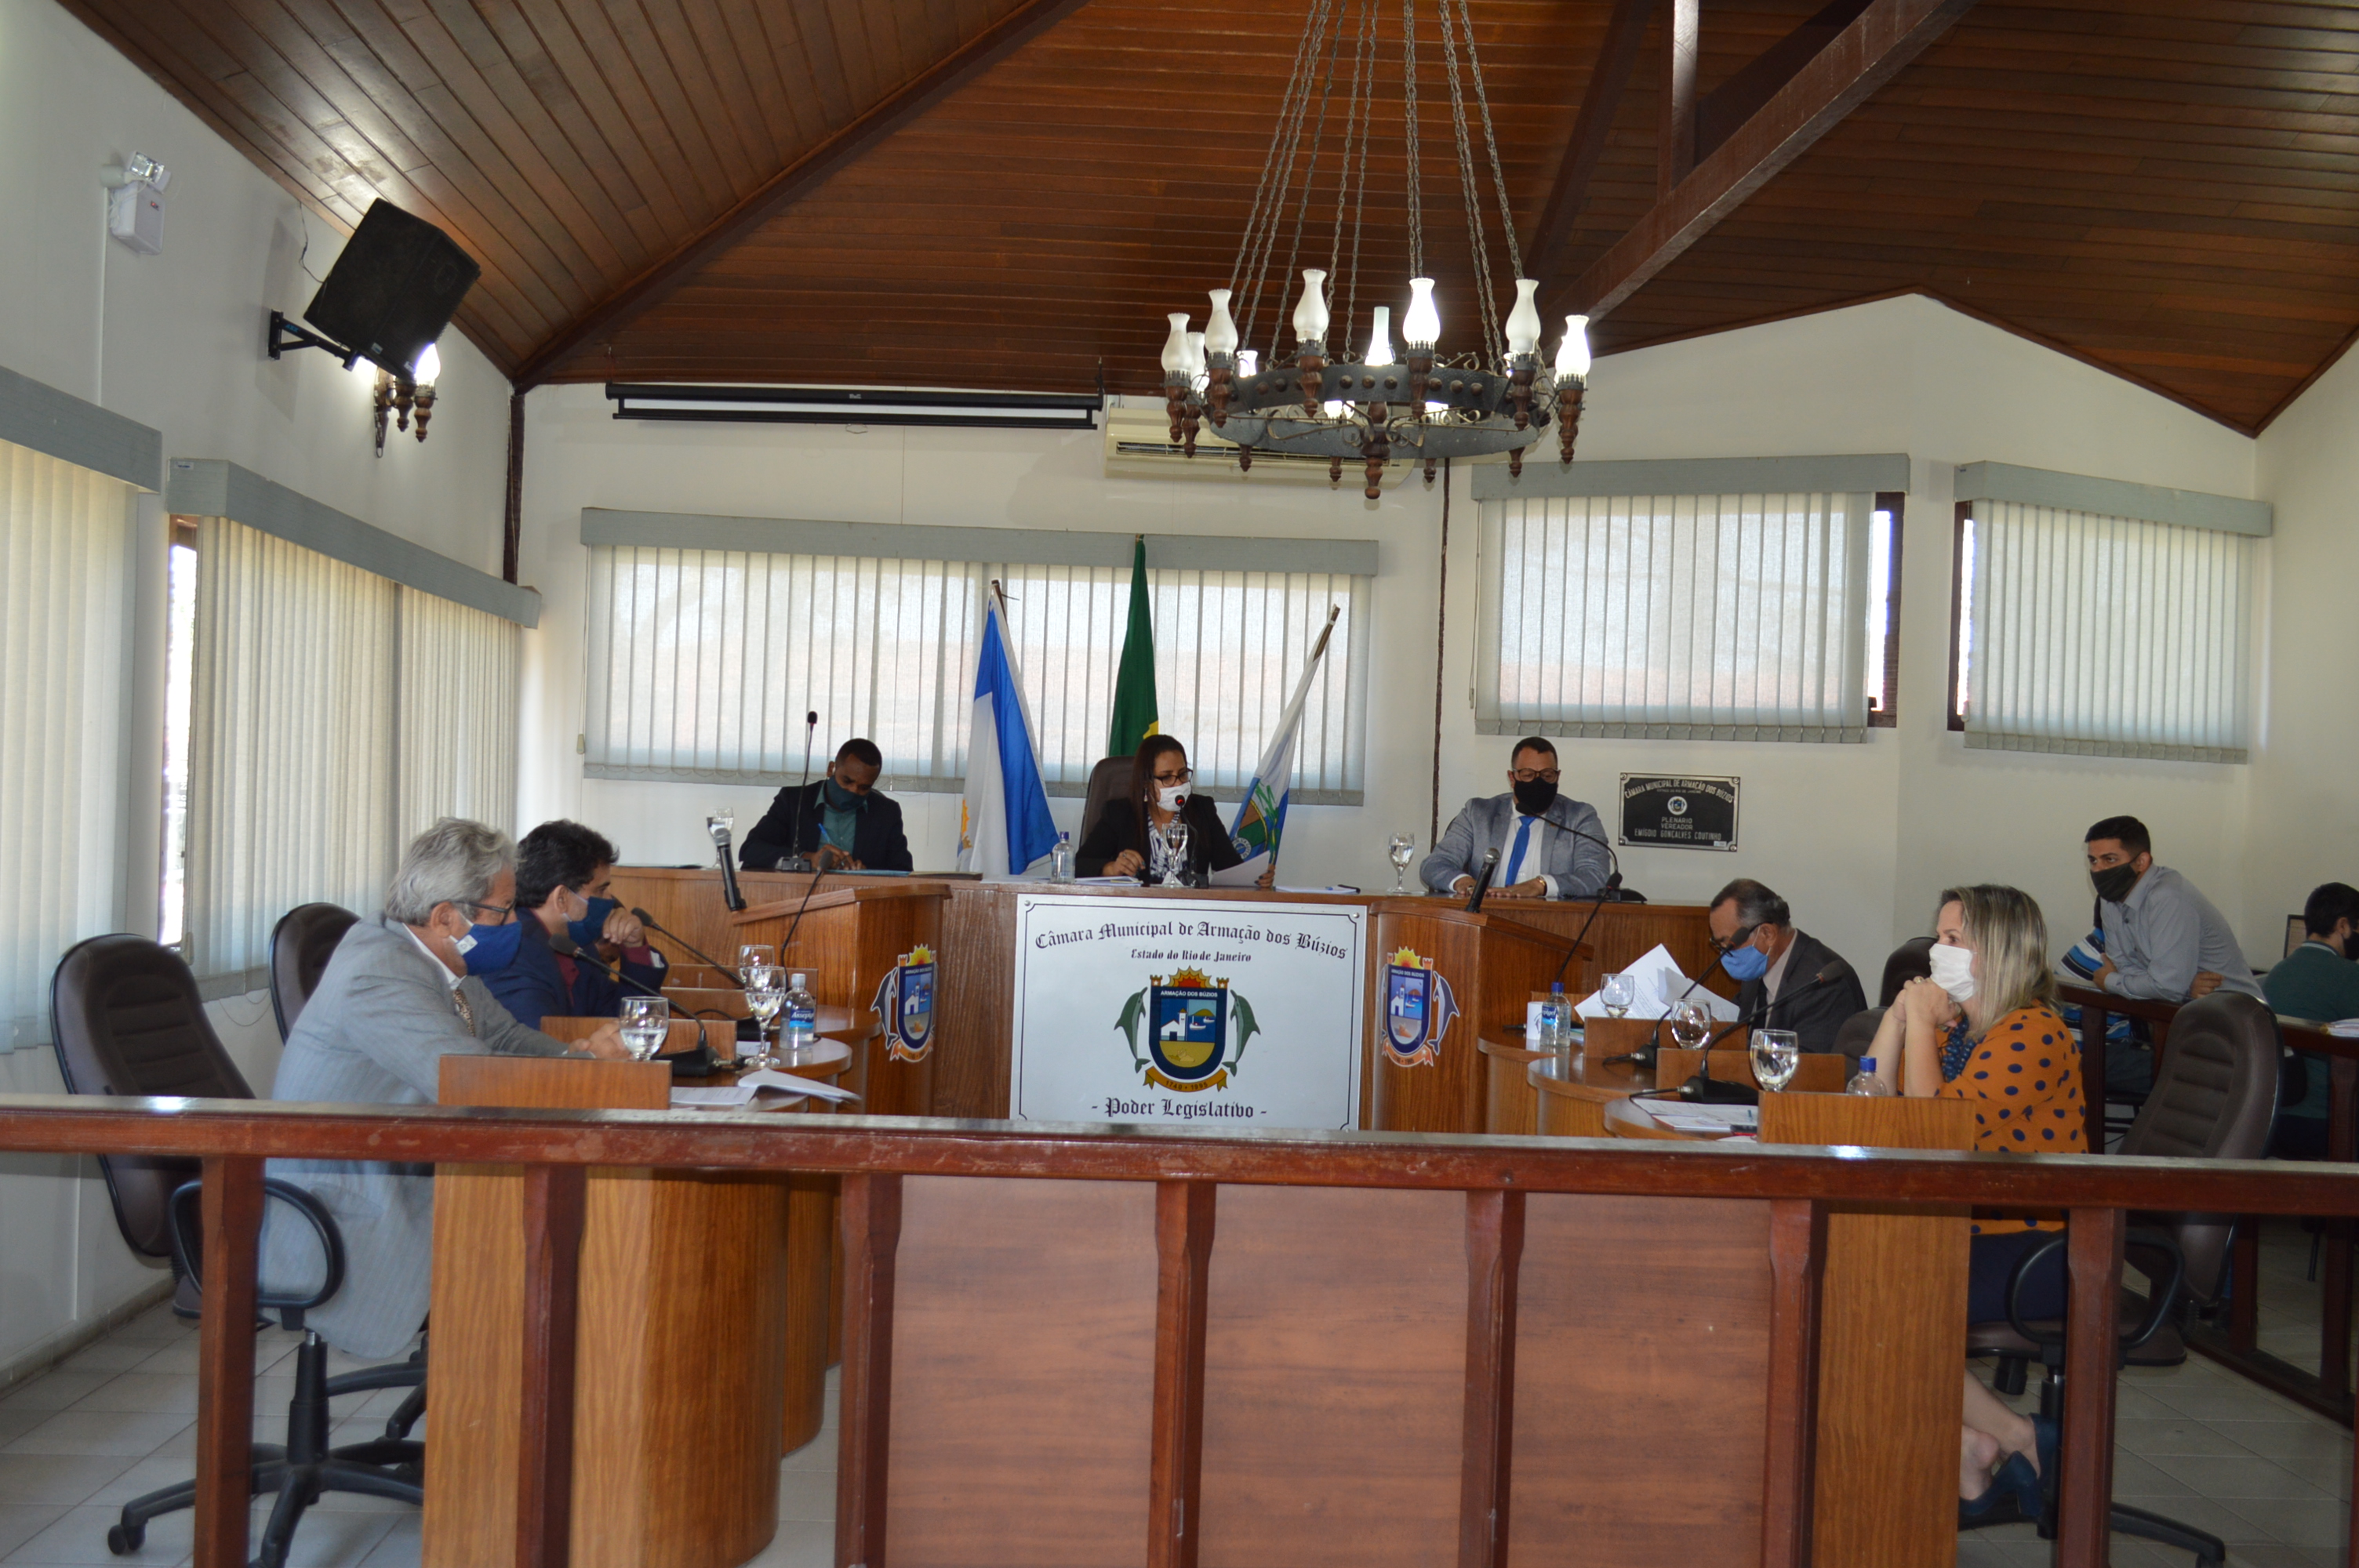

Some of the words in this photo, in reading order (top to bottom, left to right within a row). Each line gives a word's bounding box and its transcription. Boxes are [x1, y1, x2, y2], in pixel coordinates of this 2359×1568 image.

[1660, 829, 1692, 840] GONÇALVES
[1694, 831, 1722, 841] COUTINHO
[1035, 929, 1093, 949] Câmara
[1098, 921, 1173, 940] Municipal
[1179, 922, 1194, 936] de
[1197, 921, 1261, 944] Armação
[1266, 928, 1292, 946] dos
[1295, 932, 1348, 960] Búzios
[1131, 949, 1164, 960] Estado
[1166, 949, 1179, 960] do
[1213, 951, 1252, 962] Janeiro
[1165, 1080, 1183, 1091] 1740
[1190, 1081, 1209, 1091] 1995
[1104, 1097, 1155, 1117] Poder
[1161, 1098, 1254, 1120] Legislativo
